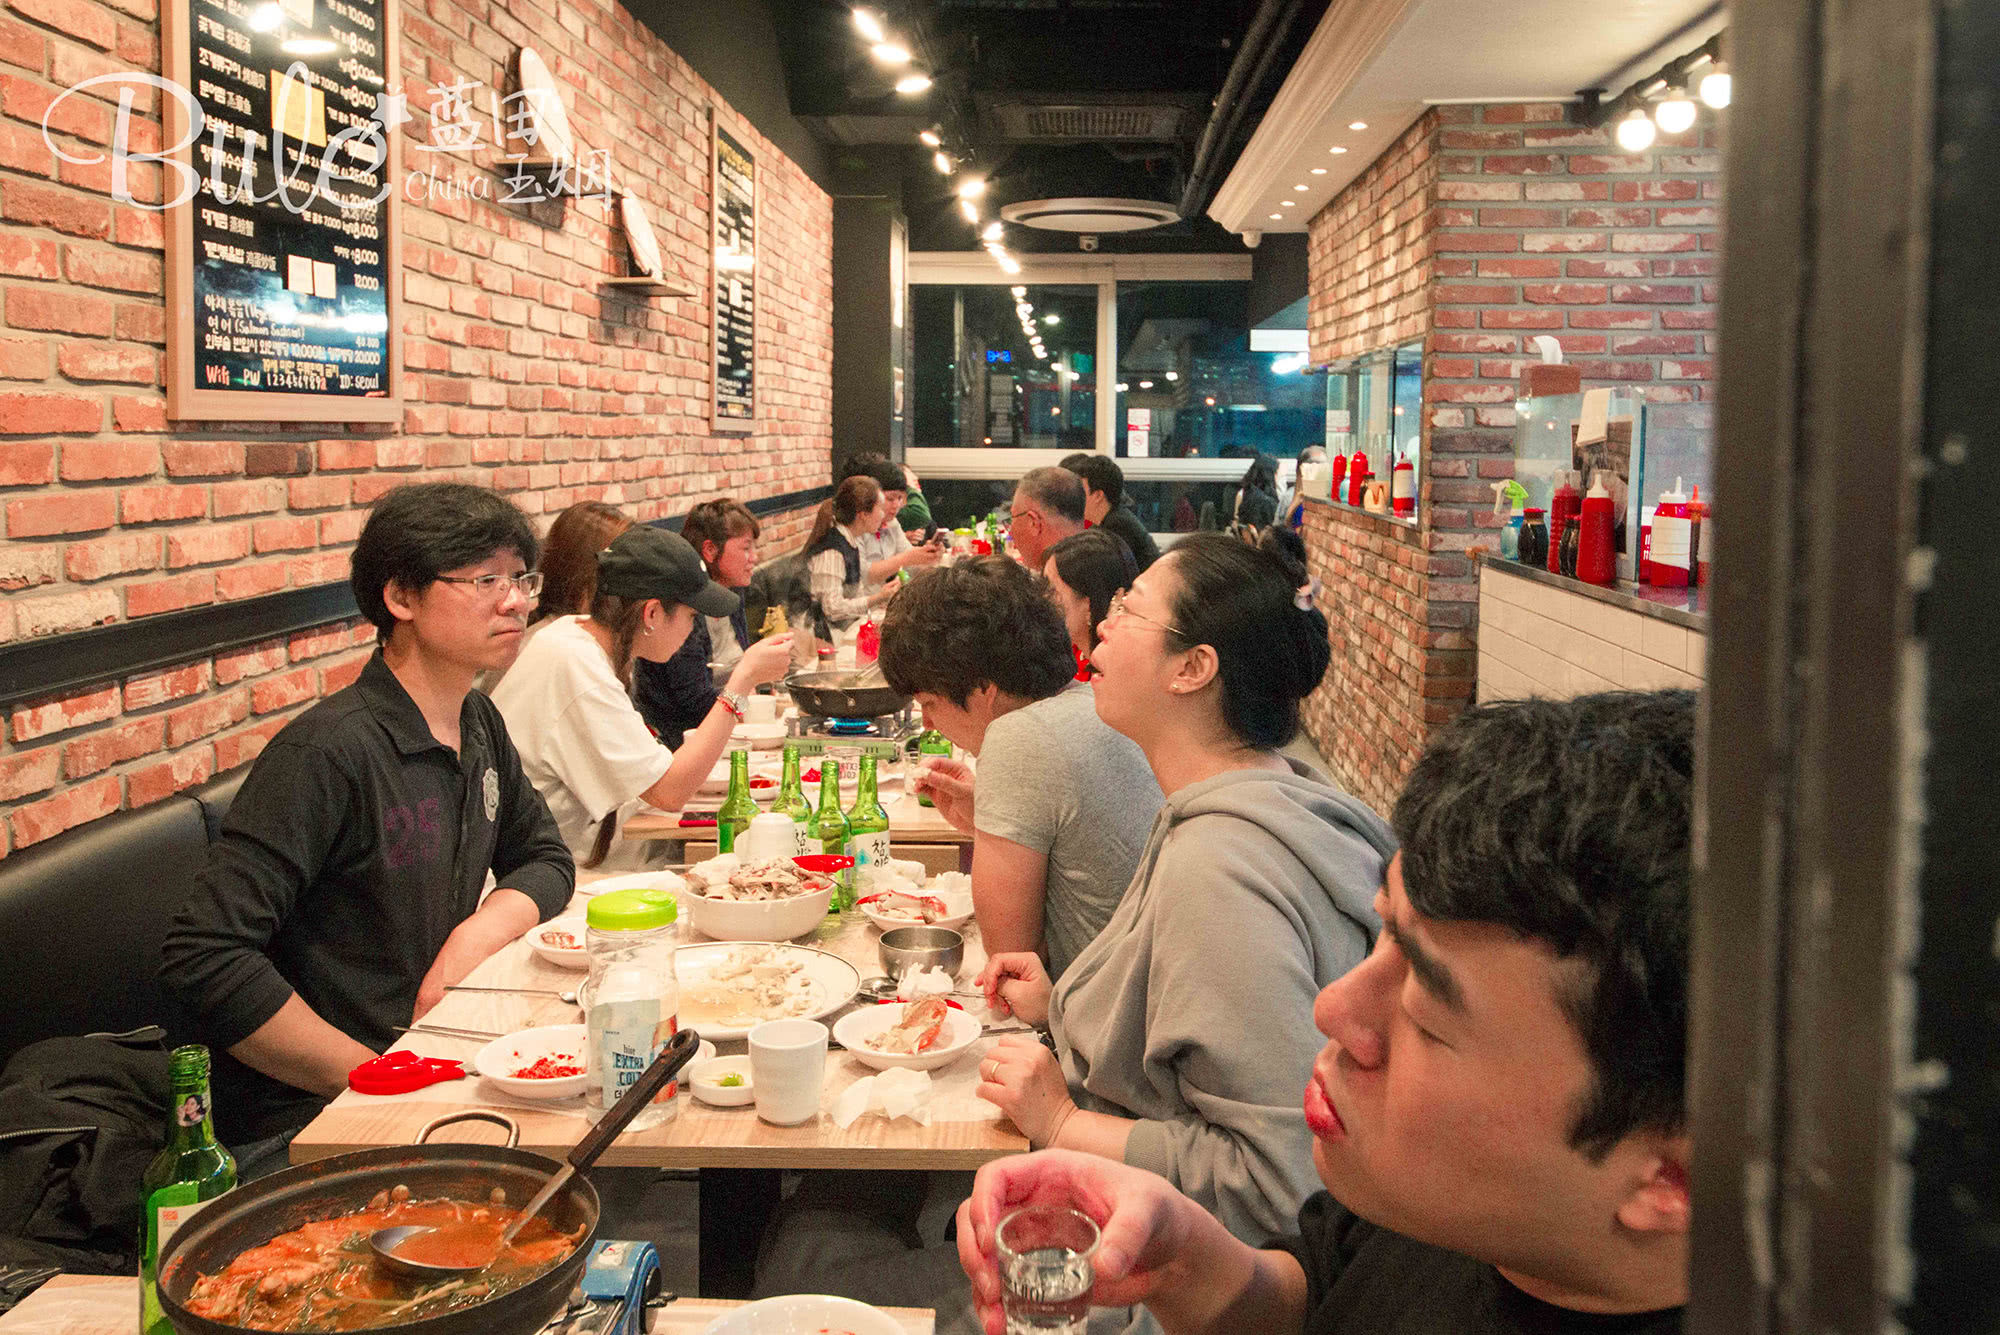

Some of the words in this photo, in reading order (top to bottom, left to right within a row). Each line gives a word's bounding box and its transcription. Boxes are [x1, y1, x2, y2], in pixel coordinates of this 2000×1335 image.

[205, 365, 230, 386] Wifi
[243, 368, 260, 386] PW
[872, 840, 886, 857] 참
[614, 1052, 644, 1069] EXTRA
